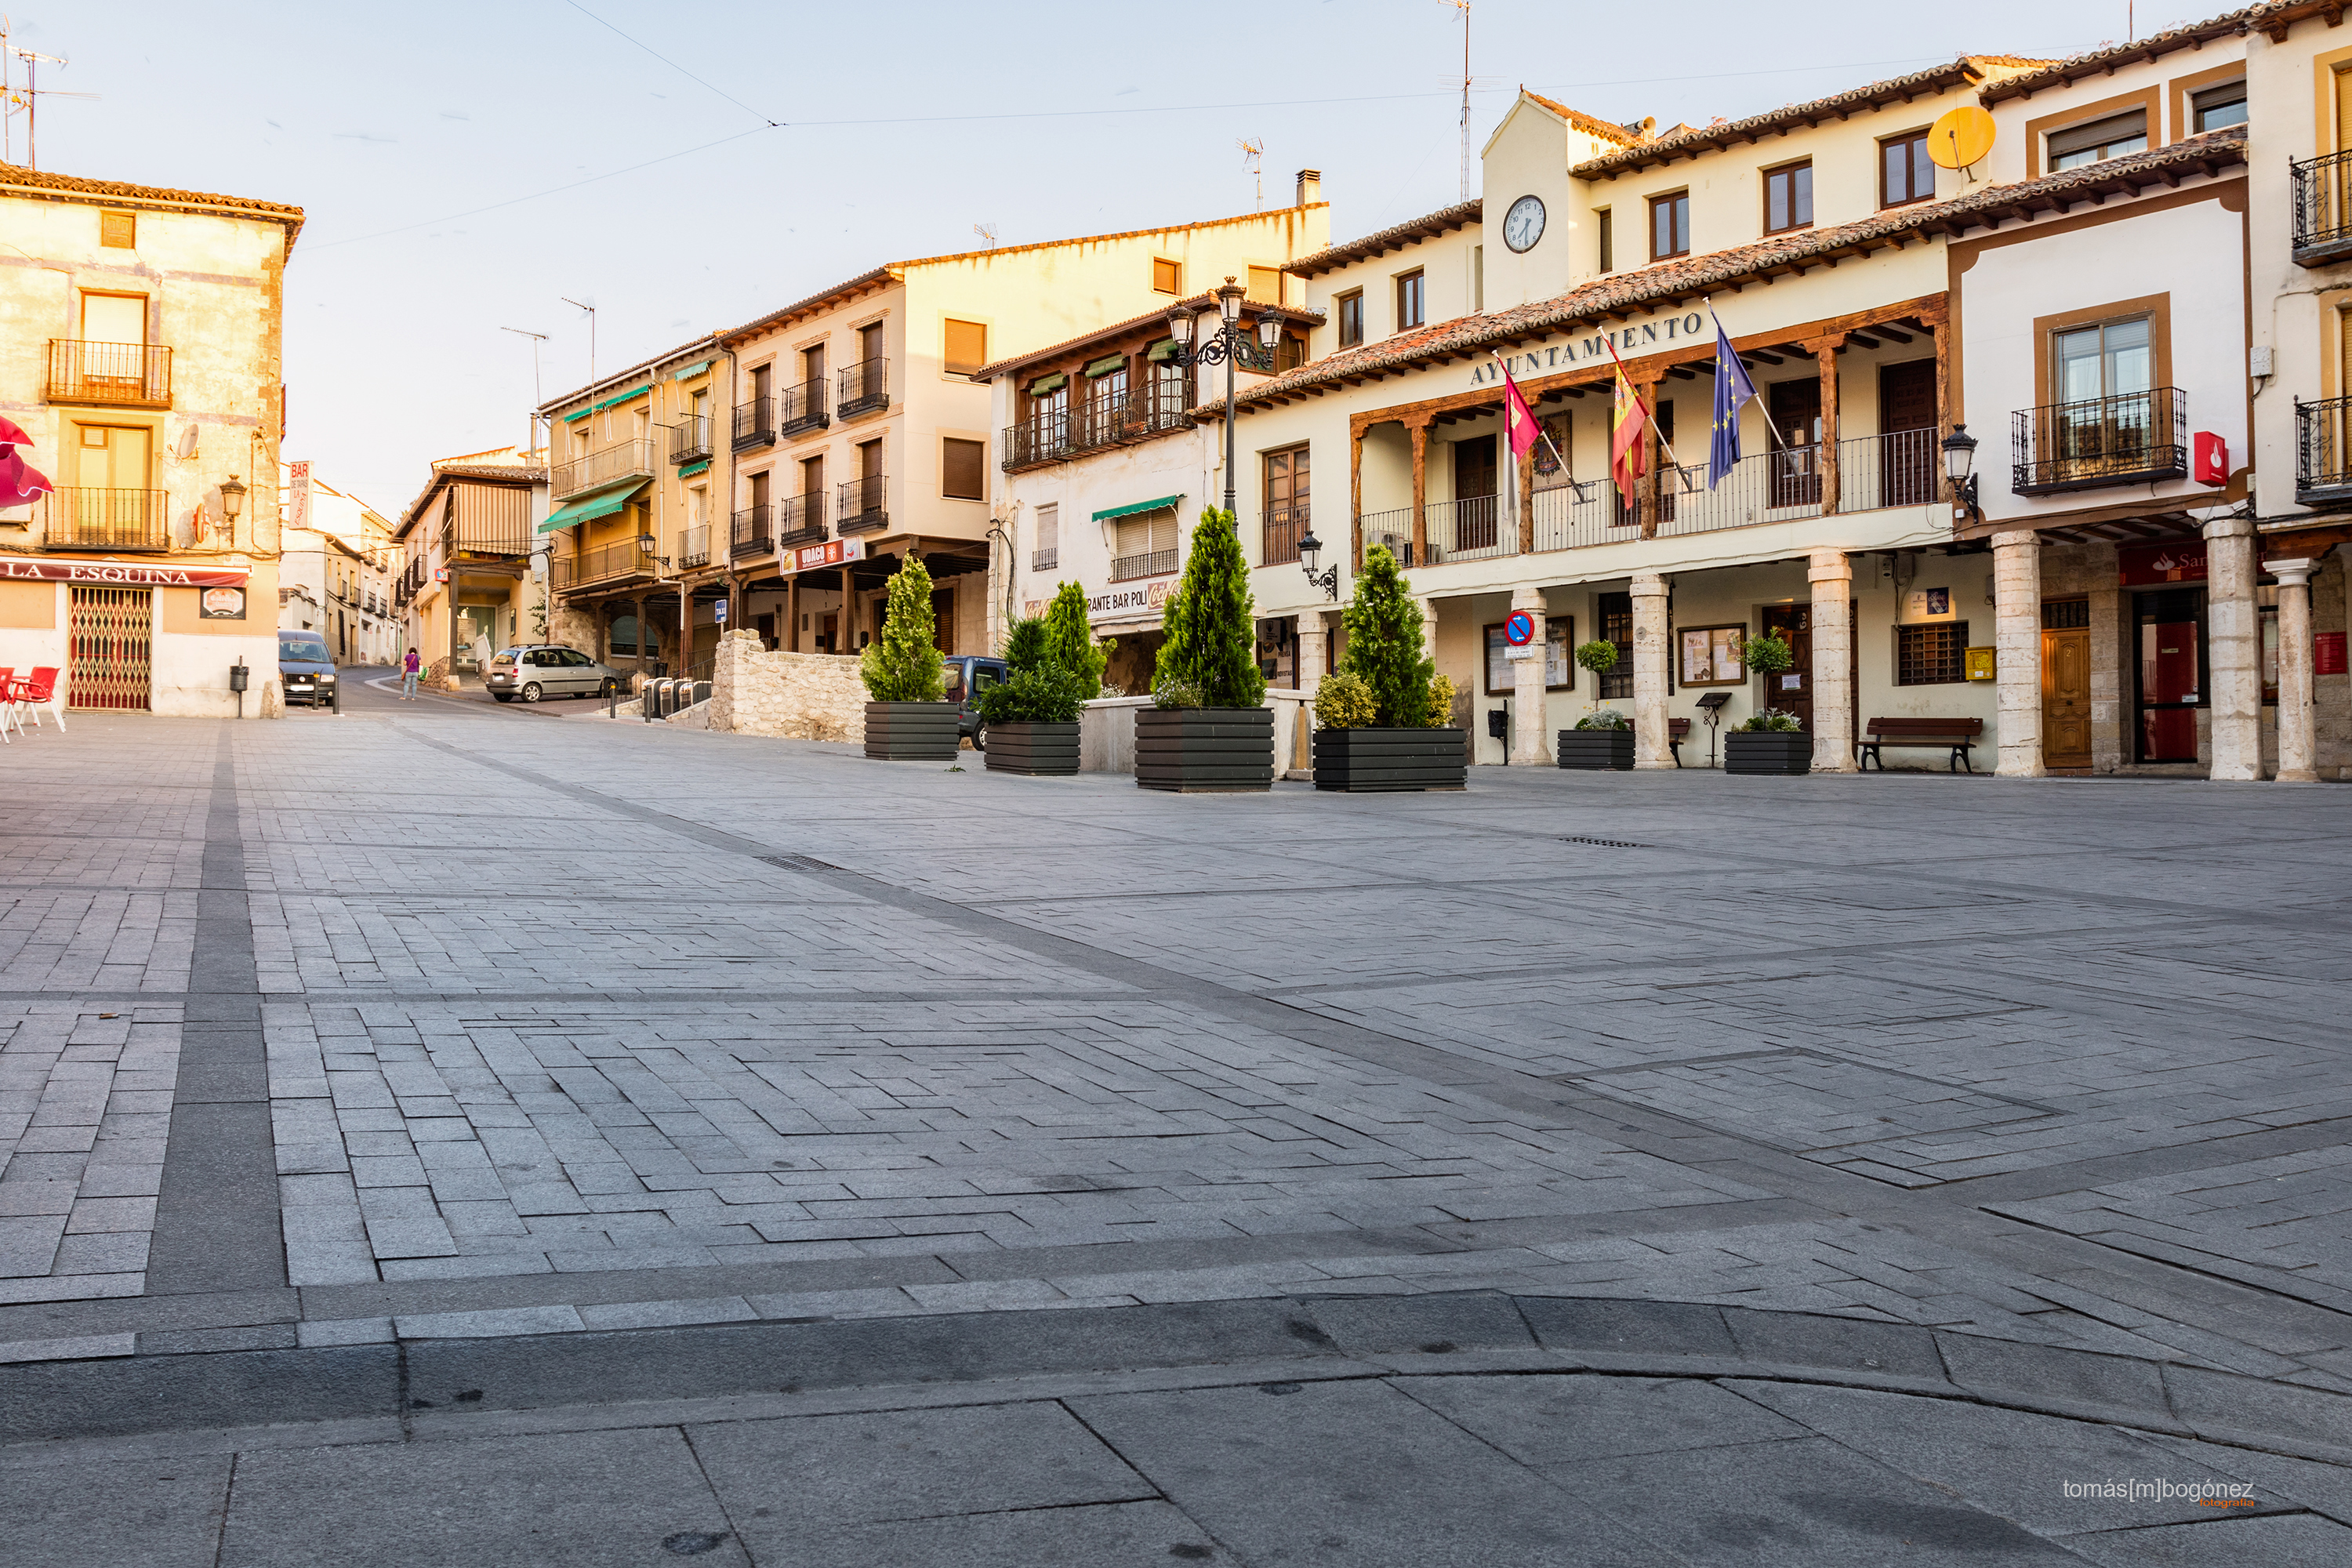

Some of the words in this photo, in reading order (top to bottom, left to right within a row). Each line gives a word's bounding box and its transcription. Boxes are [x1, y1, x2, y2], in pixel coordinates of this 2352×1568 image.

[1470, 312, 1702, 385] AYUNTAMIENTO
[292, 463, 307, 477] BAR
[294, 492, 307, 525] ESQUINA
[801, 545, 825, 563] UDACO
[6, 563, 44, 578] LA
[68, 566, 192, 584] ESQUINA
[1086, 595, 1110, 612] RANTE
[1112, 593, 1129, 609] BAR
[1131, 590, 1147, 607] POLI
